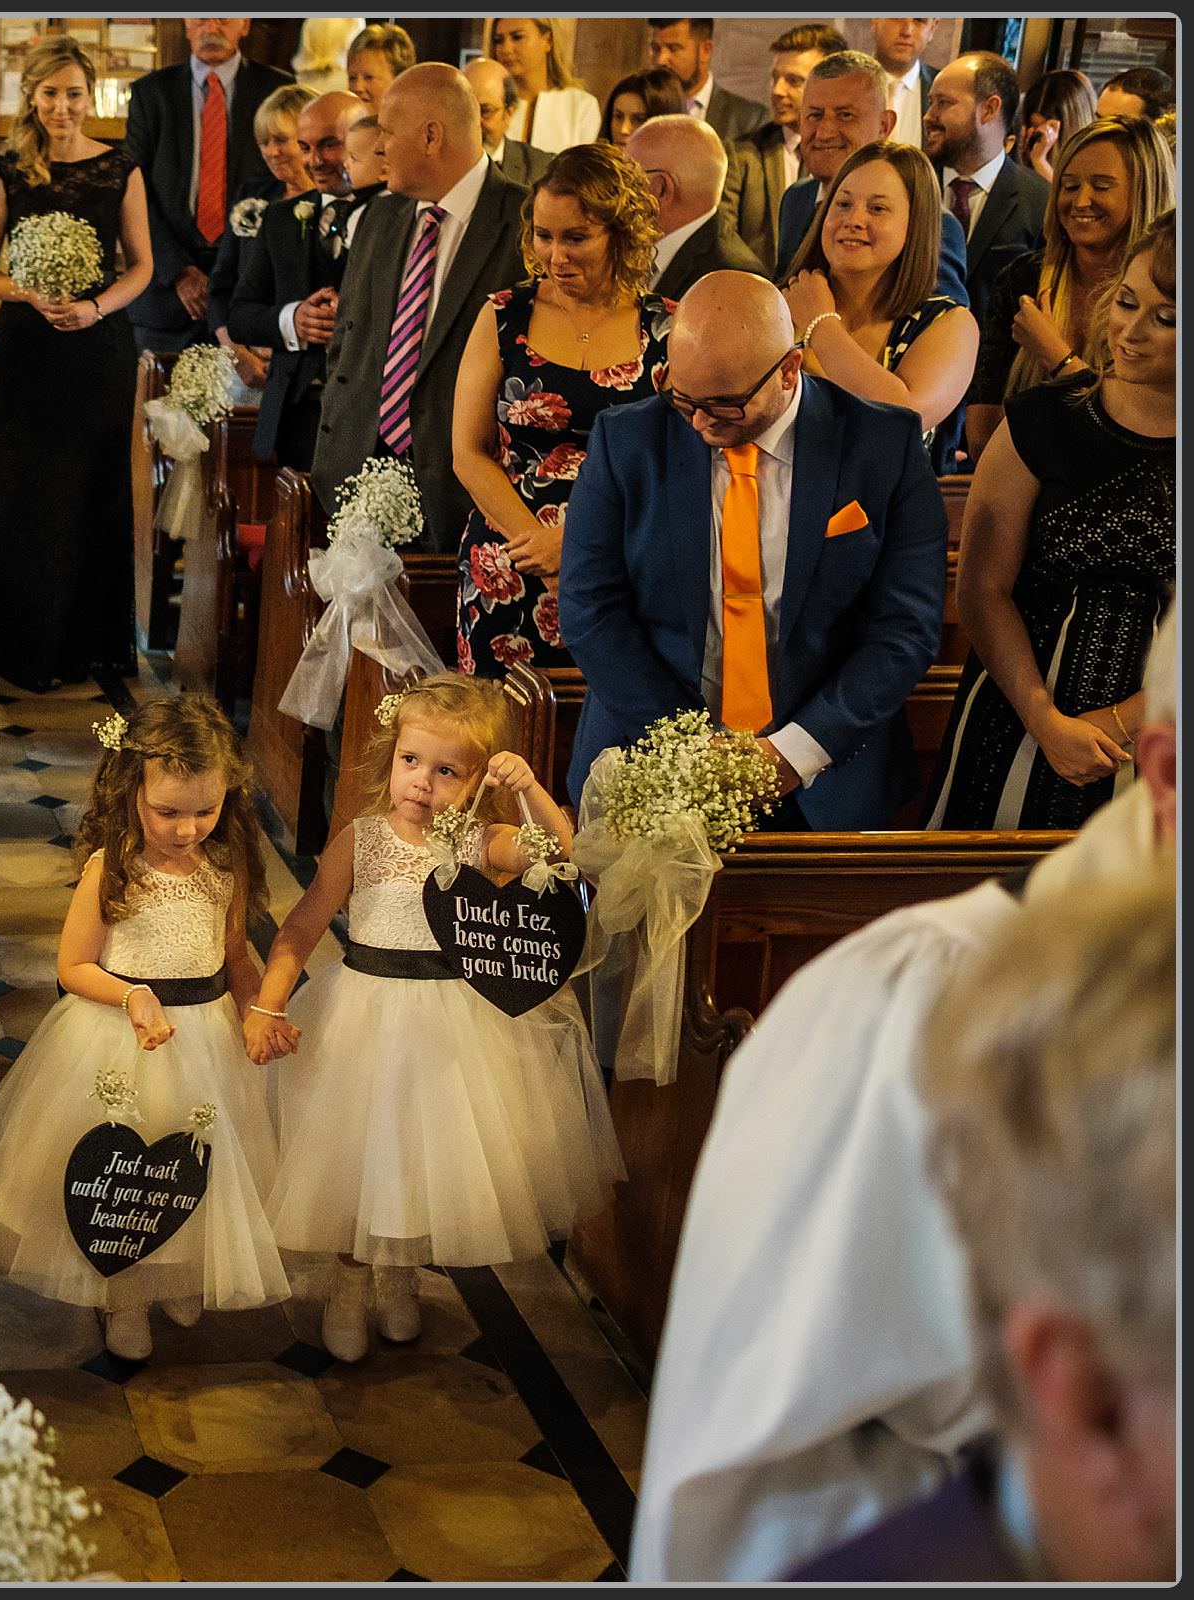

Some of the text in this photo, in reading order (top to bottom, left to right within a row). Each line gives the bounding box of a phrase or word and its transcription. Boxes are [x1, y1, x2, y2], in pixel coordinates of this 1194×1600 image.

[454, 896, 556, 935] Uncle Fez,
[453, 921, 561, 960] here comes
[462, 955, 558, 985] your bride
[104, 1151, 142, 1176] Just
[71, 1176, 198, 1210] until you see our
[89, 1203, 162, 1234] beautiful
[89, 1235, 145, 1260] auntie!
